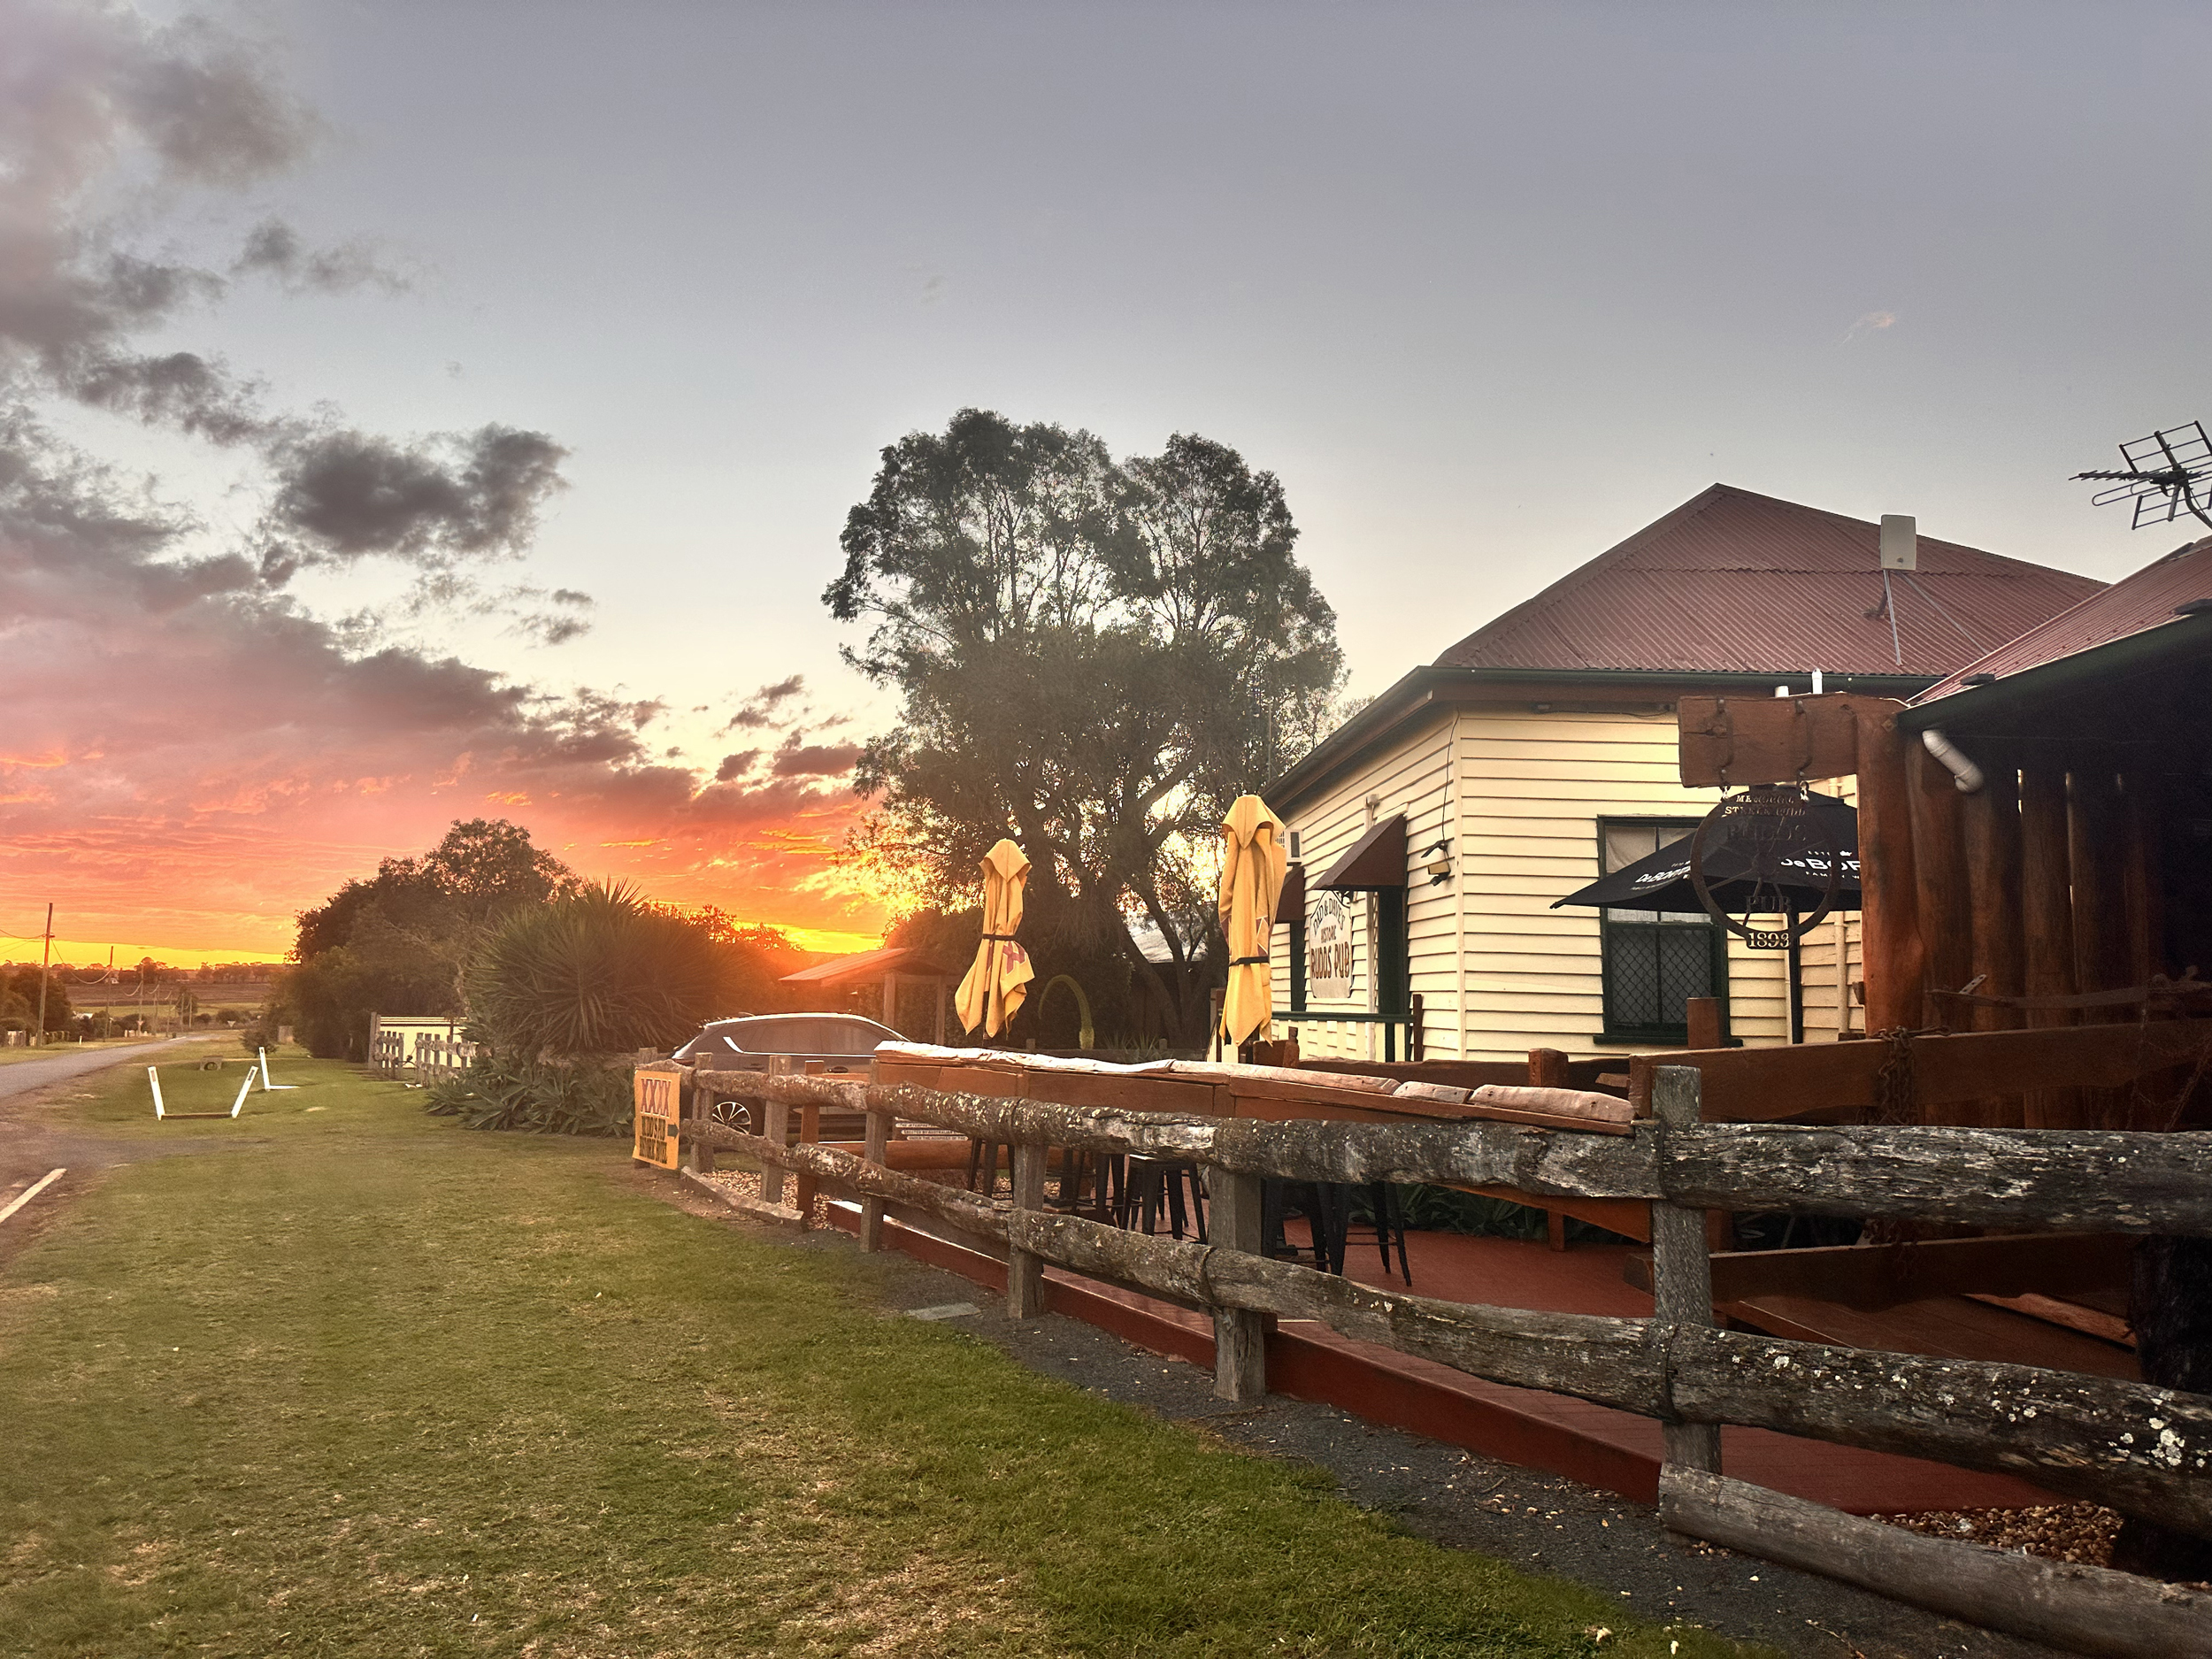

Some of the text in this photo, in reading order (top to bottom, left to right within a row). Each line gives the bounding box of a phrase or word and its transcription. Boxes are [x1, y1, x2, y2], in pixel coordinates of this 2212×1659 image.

[1313, 905, 1325, 935] DAD
[1325, 901, 1329, 916] &
[1744, 895, 1793, 912] PUB
[1747, 932, 1790, 949] 1893
[1333, 941, 1350, 979] PUB
[640, 1078, 672, 1118] XXXX
